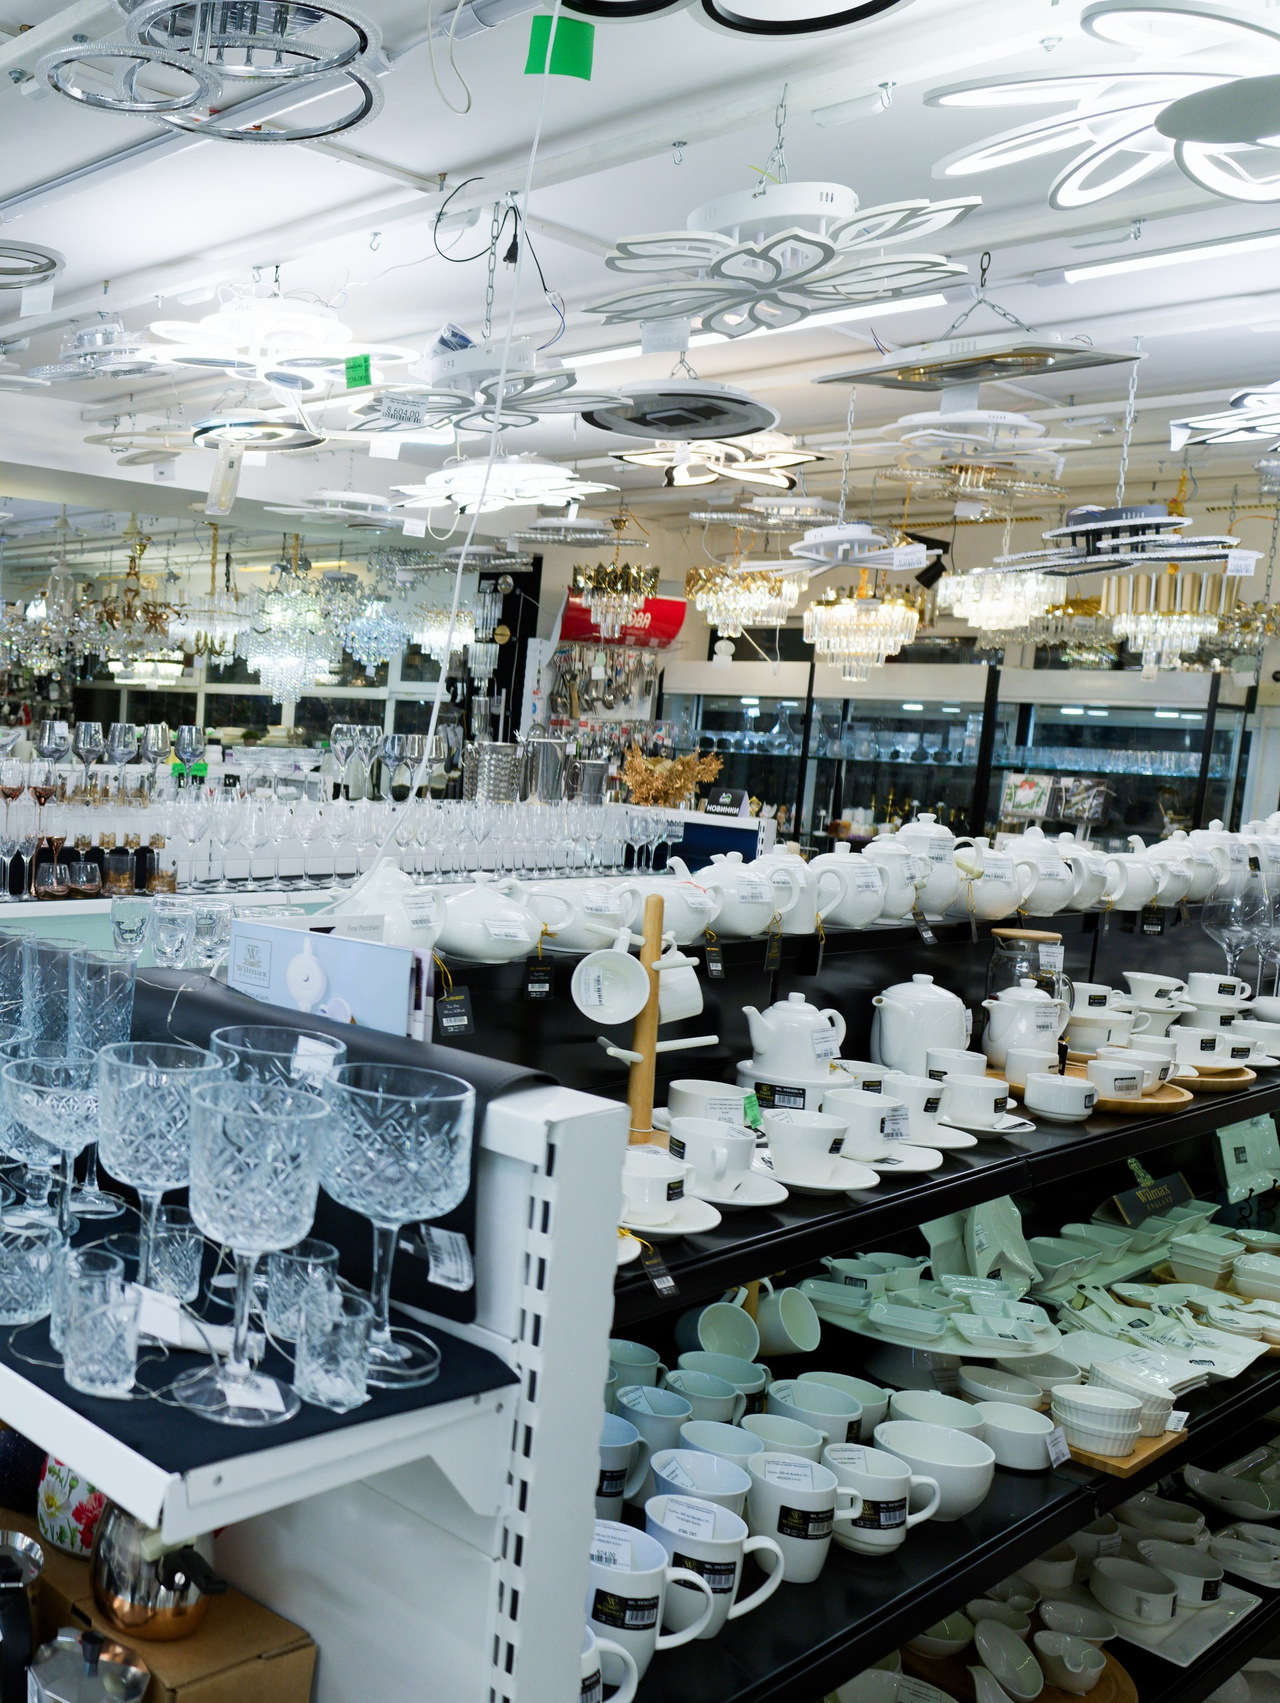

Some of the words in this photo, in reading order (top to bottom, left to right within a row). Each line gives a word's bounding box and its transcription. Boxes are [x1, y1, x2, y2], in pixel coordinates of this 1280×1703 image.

[706, 804, 740, 815] НОВИНКИ
[236, 963, 268, 978] Wilmax
[1135, 1184, 1171, 1204] Wilmax
